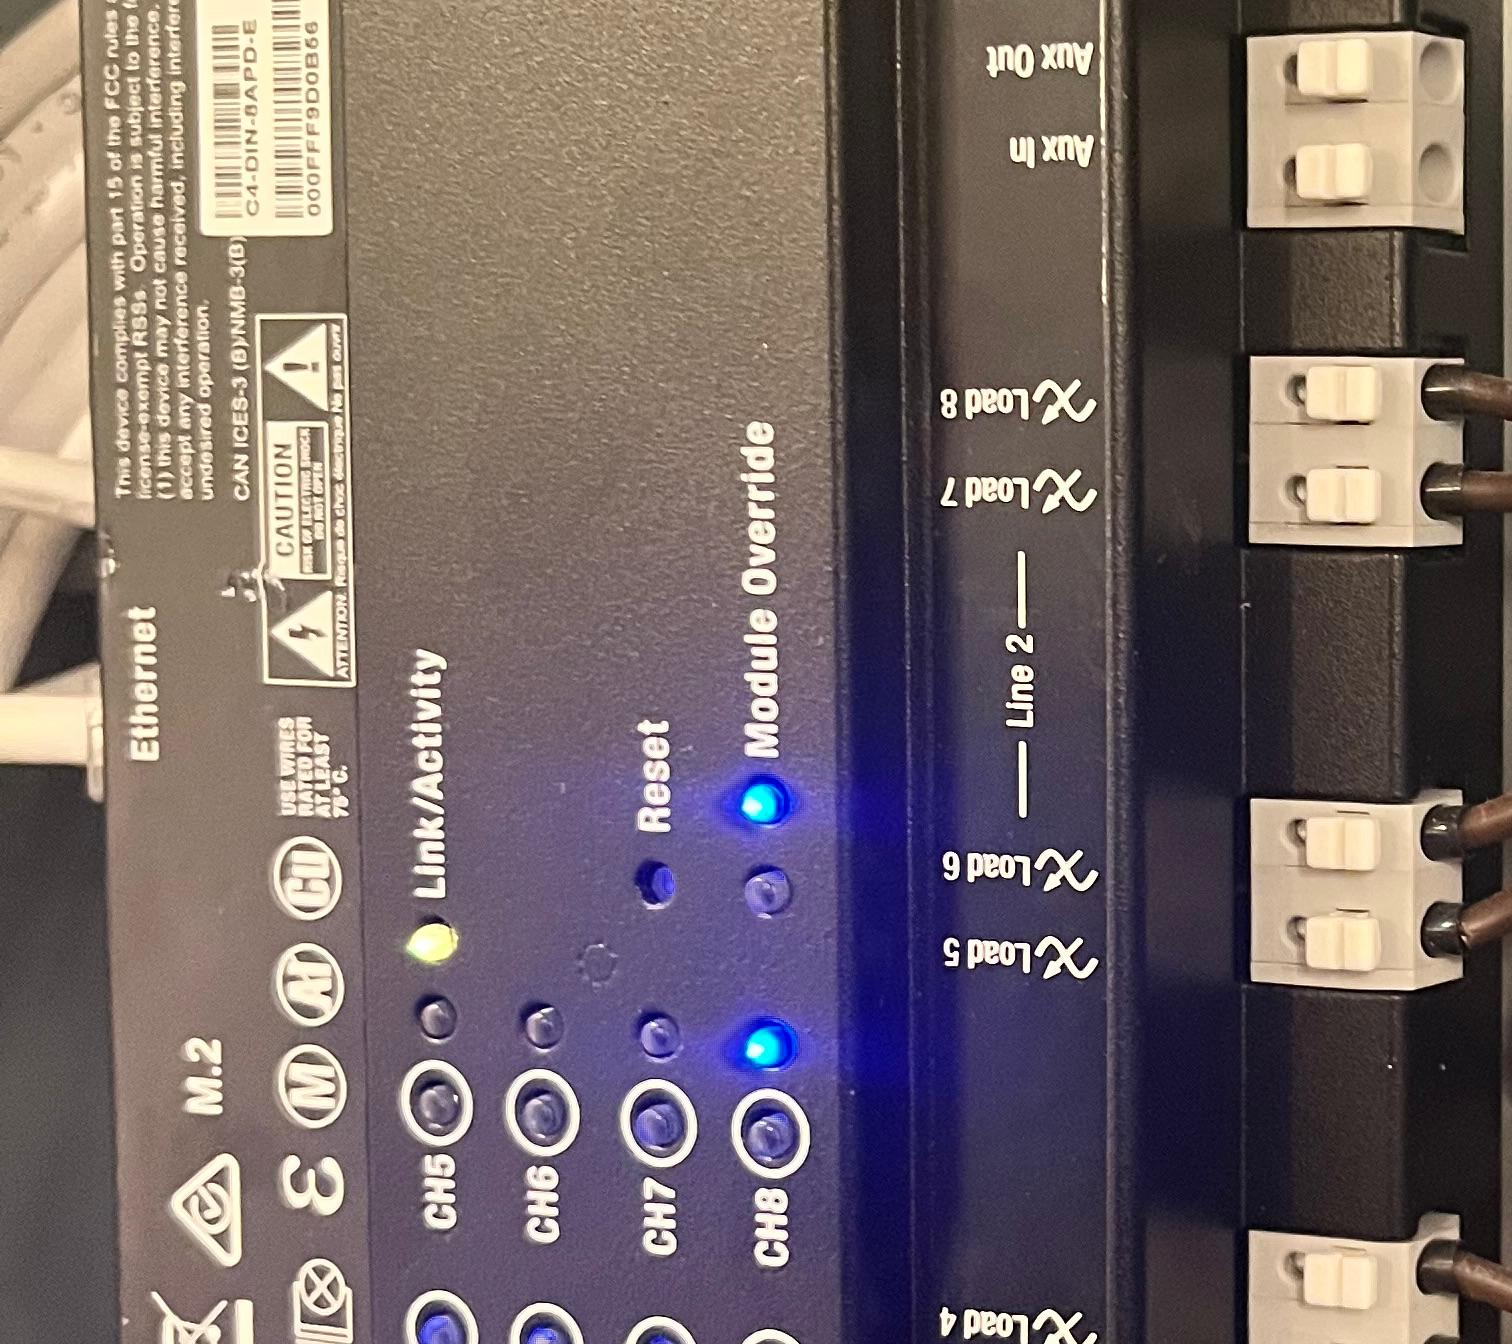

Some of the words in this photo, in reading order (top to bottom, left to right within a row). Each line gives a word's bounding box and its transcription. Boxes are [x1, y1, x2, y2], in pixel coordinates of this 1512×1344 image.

[985, 43, 1035, 79] Out
[1040, 41, 1094, 76] Aux
[242, 19, 260, 217] C4-DIN-8APD-E
[1009, 136, 1036, 169] In
[1041, 134, 1095, 168] Aux
[230, 376, 249, 448] ICES-3
[940, 388, 958, 419] 8
[964, 387, 1029, 421] Load
[196, 402, 215, 501] undesired
[232, 453, 251, 501] CAN
[273, 443, 295, 557] CAUTION
[739, 420, 777, 595] Override
[940, 476, 959, 507] 7
[965, 476, 1030, 510] Load
[1005, 634, 1034, 654] 2
[127, 606, 160, 762] Ethernet
[743, 608, 780, 759] Module
[1005, 664, 1035, 728] Line
[407, 648, 448, 899] Link/Activity
[636, 719, 672, 833] Reset
[942, 851, 961, 881] 6
[967, 852, 1031, 887] Load
[943, 937, 960, 967] 5
[967, 938, 1031, 974] Load
[183, 1037, 224, 1115] M.2
[423, 1153, 457, 1230] CH5
[525, 1165, 560, 1244] CH6
[641, 1176, 677, 1256] CH7
[753, 1187, 790, 1268] CH8
[939, 1306, 957, 1337] 4
